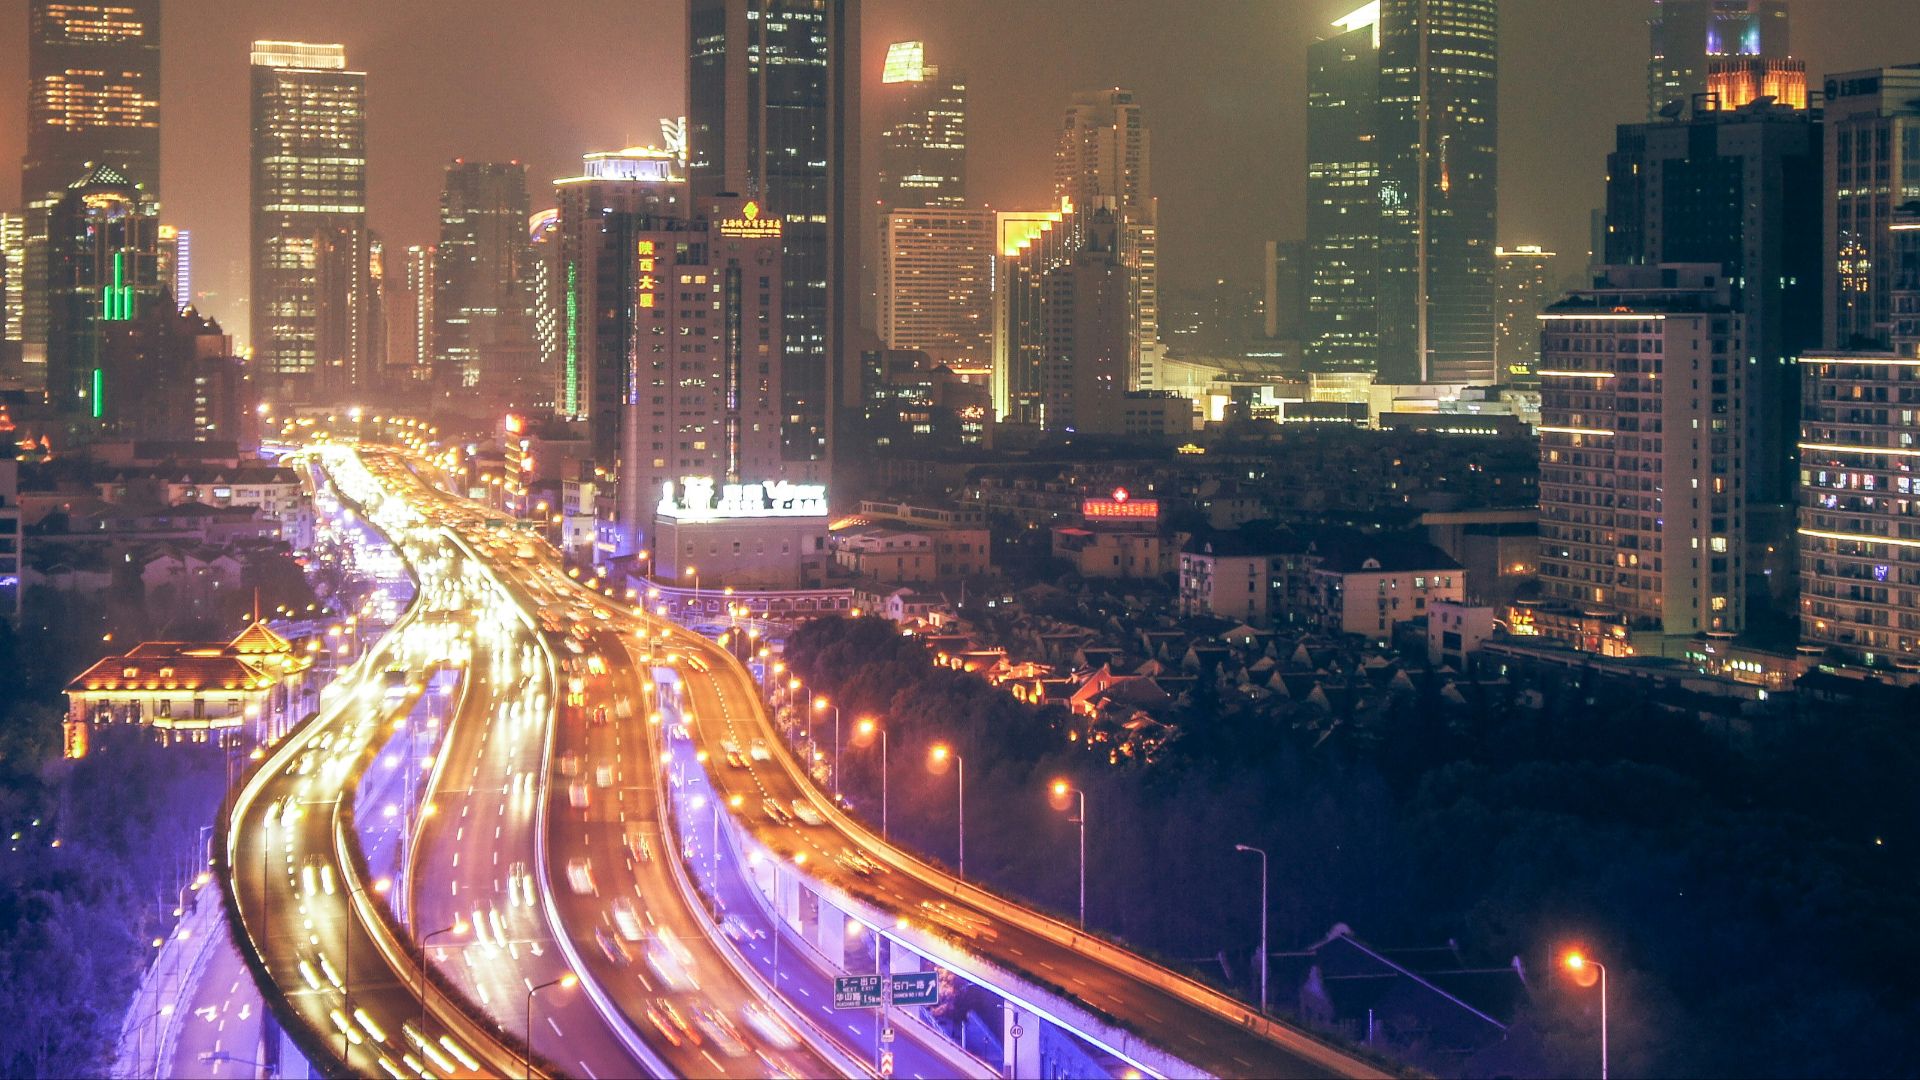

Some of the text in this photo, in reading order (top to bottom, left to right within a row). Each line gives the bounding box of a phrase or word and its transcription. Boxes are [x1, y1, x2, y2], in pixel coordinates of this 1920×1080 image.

[840, 977, 877, 987] 下一出口
[894, 981, 924, 990] 石门一路
